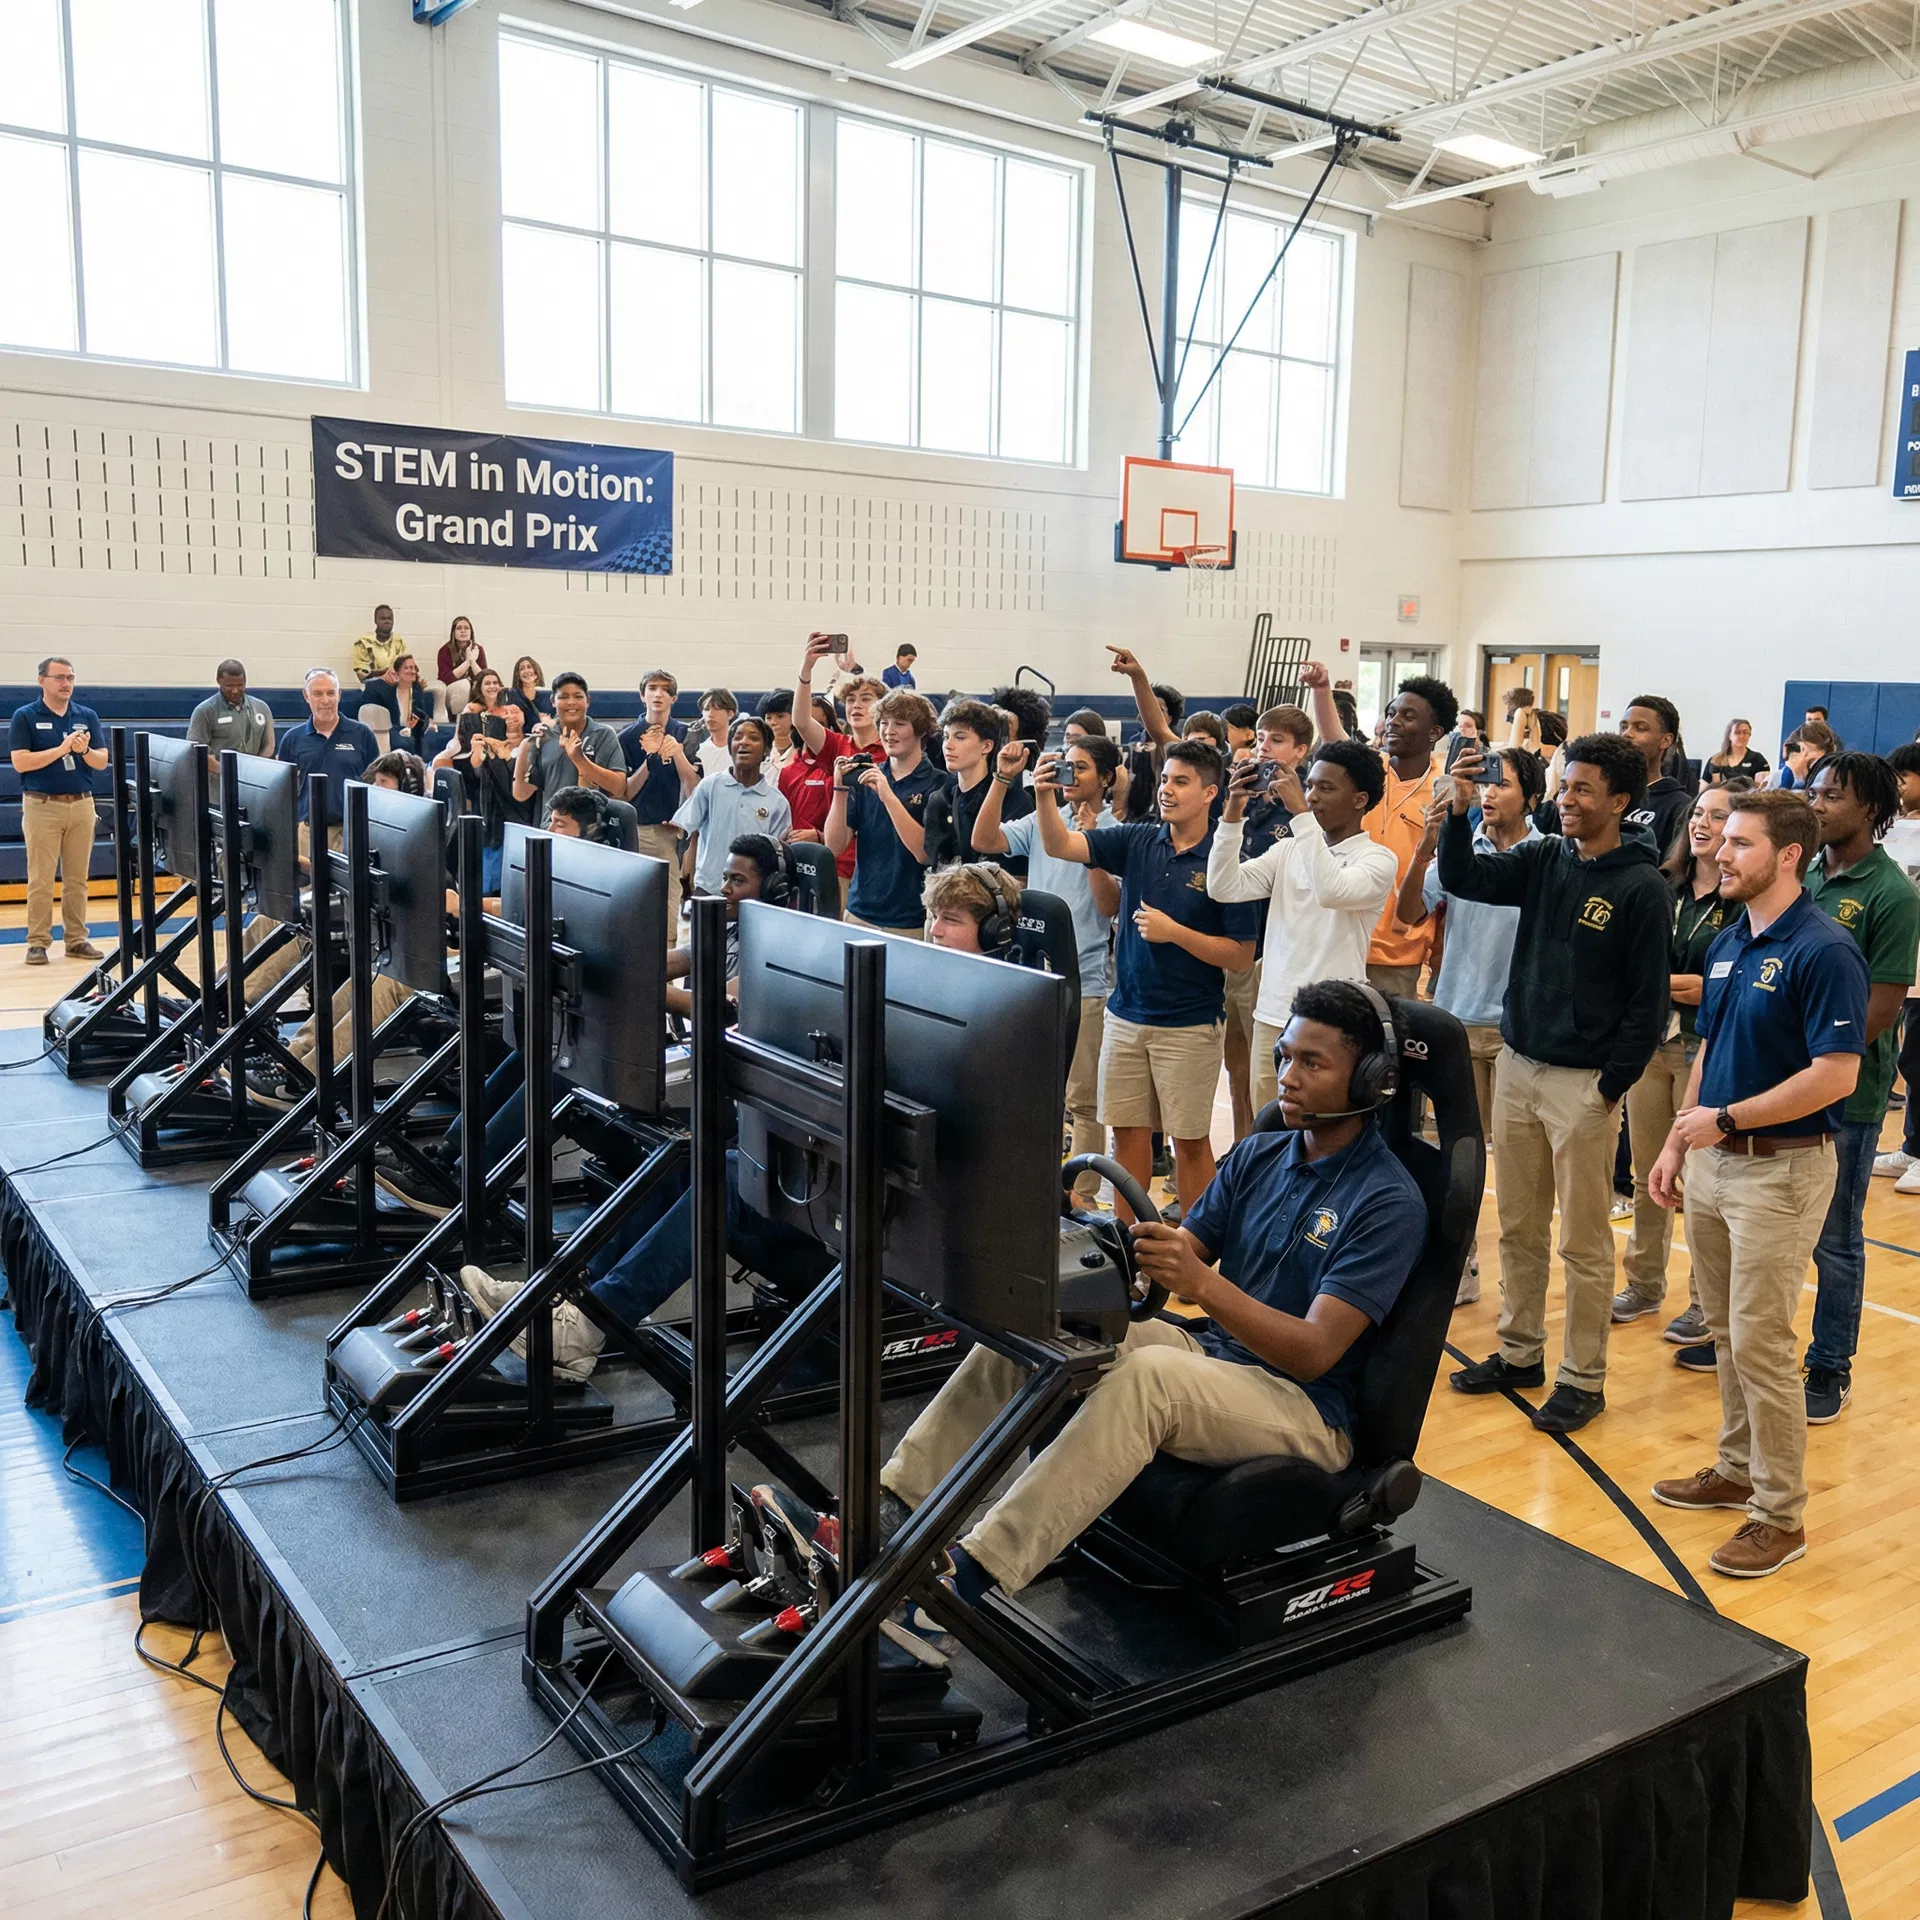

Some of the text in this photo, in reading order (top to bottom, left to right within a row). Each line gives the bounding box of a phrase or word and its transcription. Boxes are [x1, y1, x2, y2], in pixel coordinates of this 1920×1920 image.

[335, 441, 653, 504] STEM in Motion:
[395, 503, 599, 552] Grand Prix
